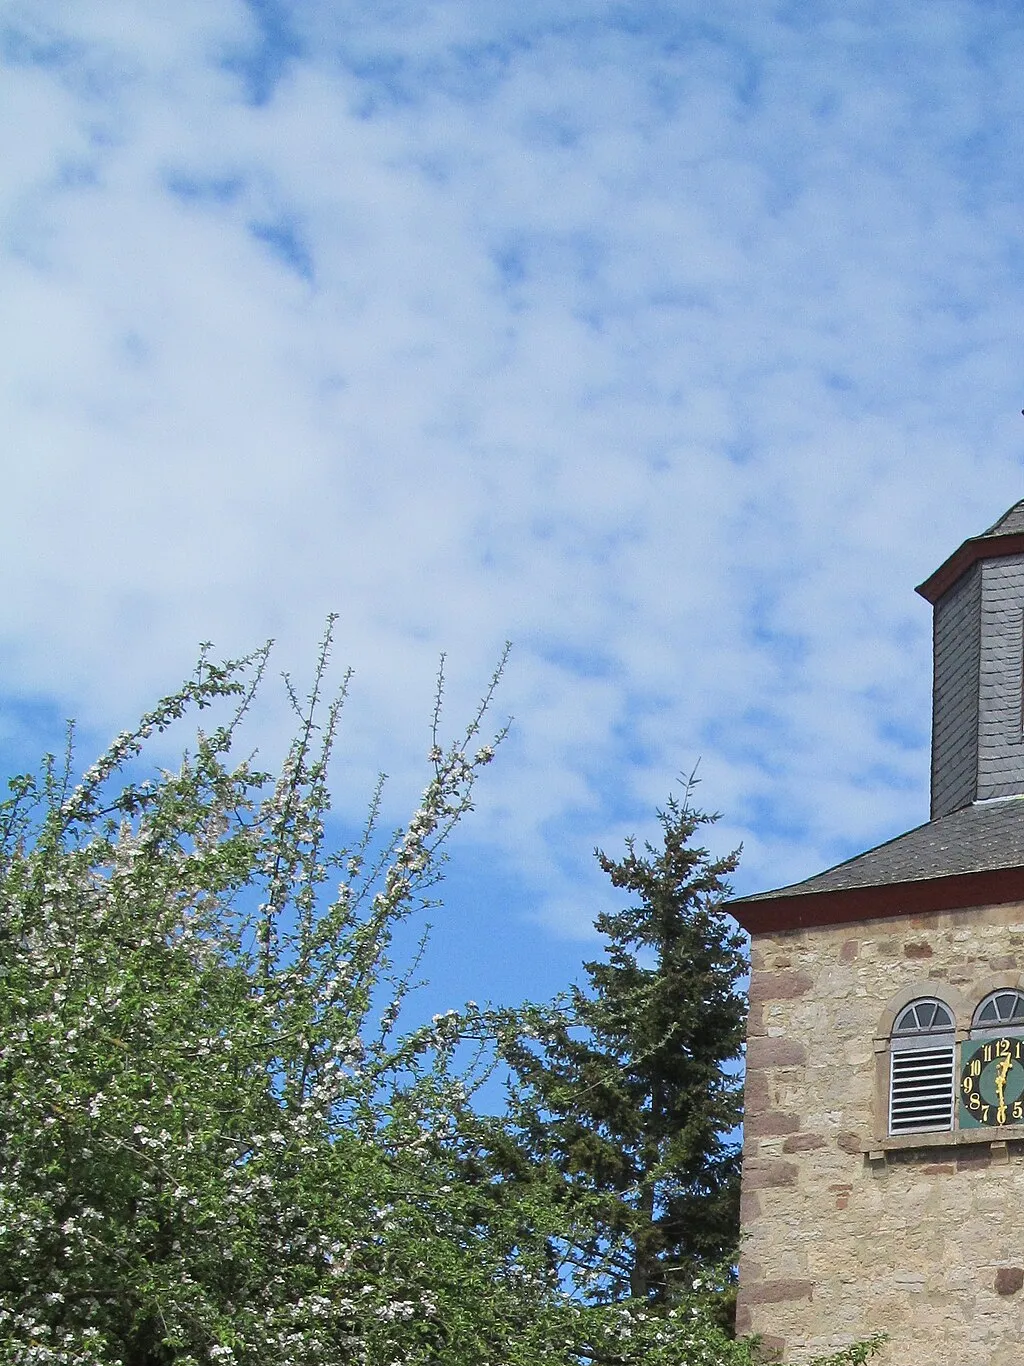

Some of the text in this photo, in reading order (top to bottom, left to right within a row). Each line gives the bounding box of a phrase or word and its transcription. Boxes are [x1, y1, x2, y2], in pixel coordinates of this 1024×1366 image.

[984, 1045, 992, 1062] 11
[996, 1040, 1010, 1057] 12
[1015, 1042, 1021, 1059] 1
[970, 1059, 981, 1077] 10
[963, 1076, 973, 1094] 9
[969, 1092, 980, 1110] 8
[1012, 1101, 1023, 1118] 5
[981, 1105, 990, 1122] 7
